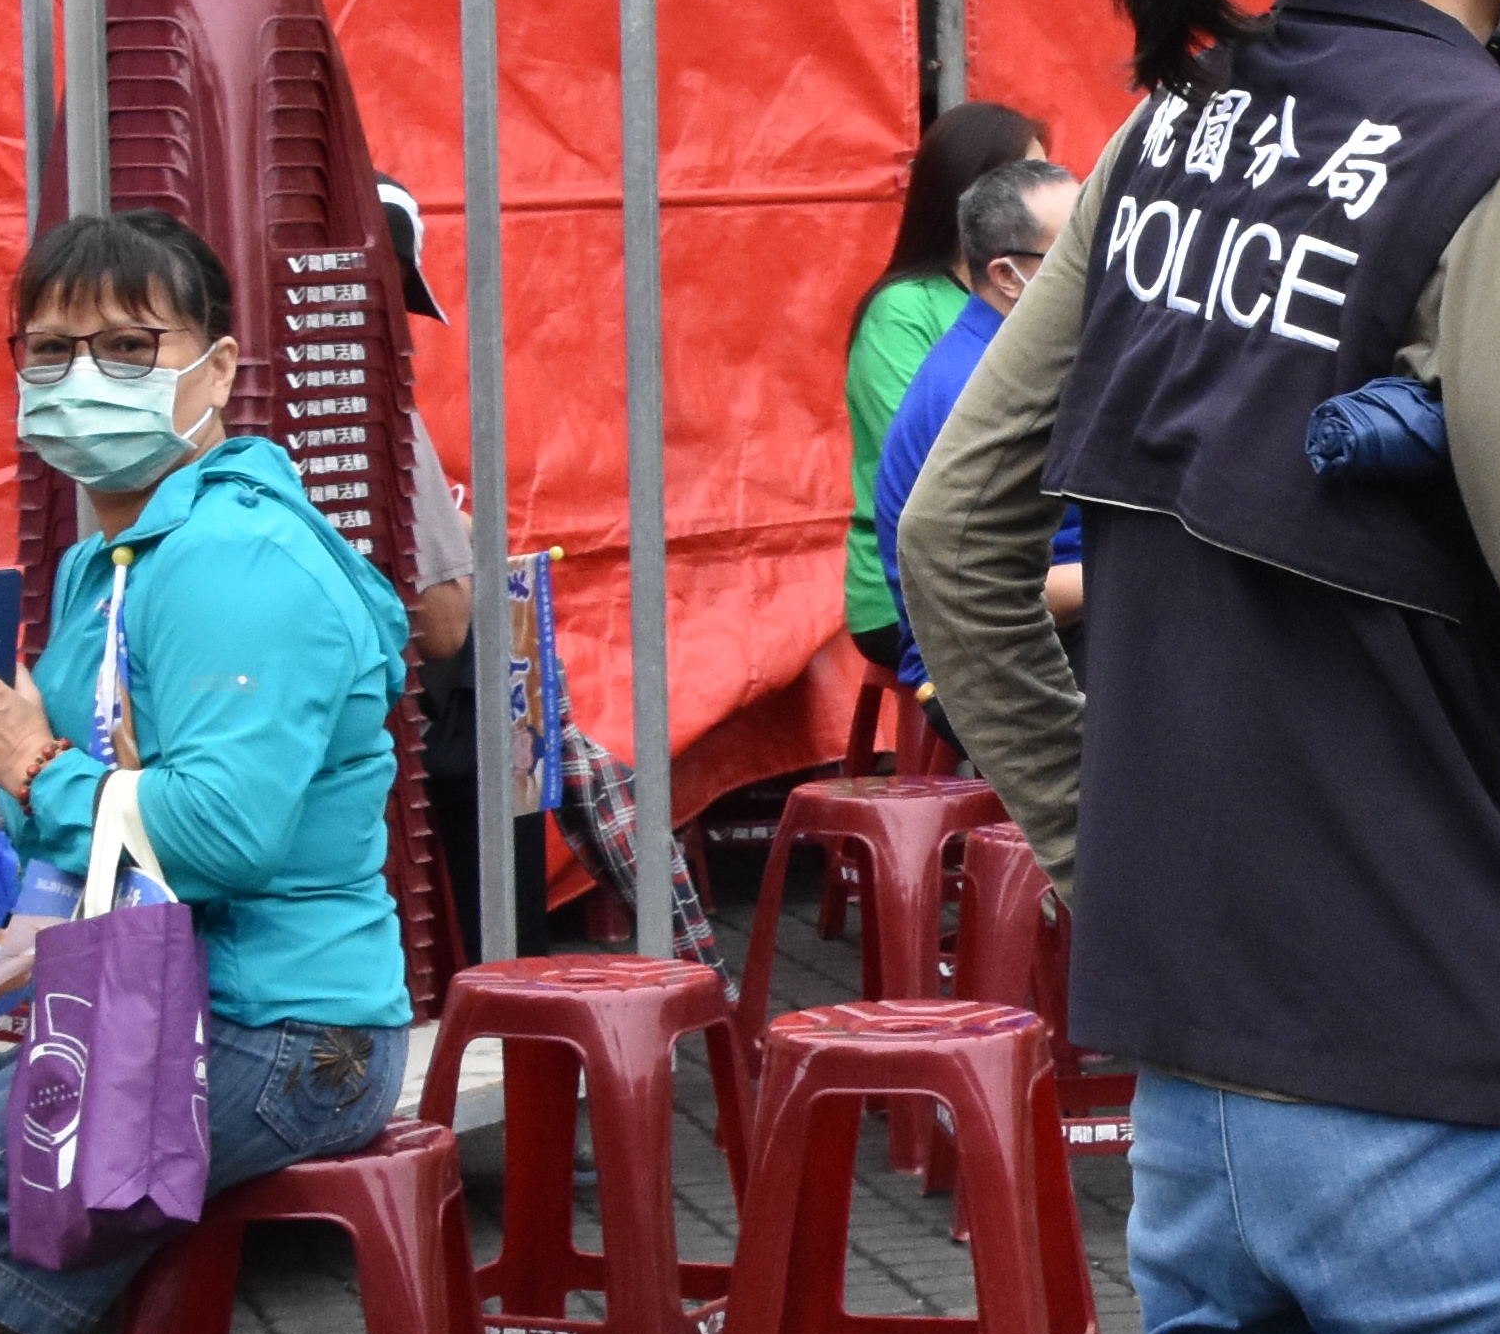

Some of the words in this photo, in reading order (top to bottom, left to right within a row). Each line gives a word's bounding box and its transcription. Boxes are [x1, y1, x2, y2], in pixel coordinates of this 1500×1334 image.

[1139, 88, 1402, 221] 桃園分局
[1106, 195, 1360, 352] POLICE
